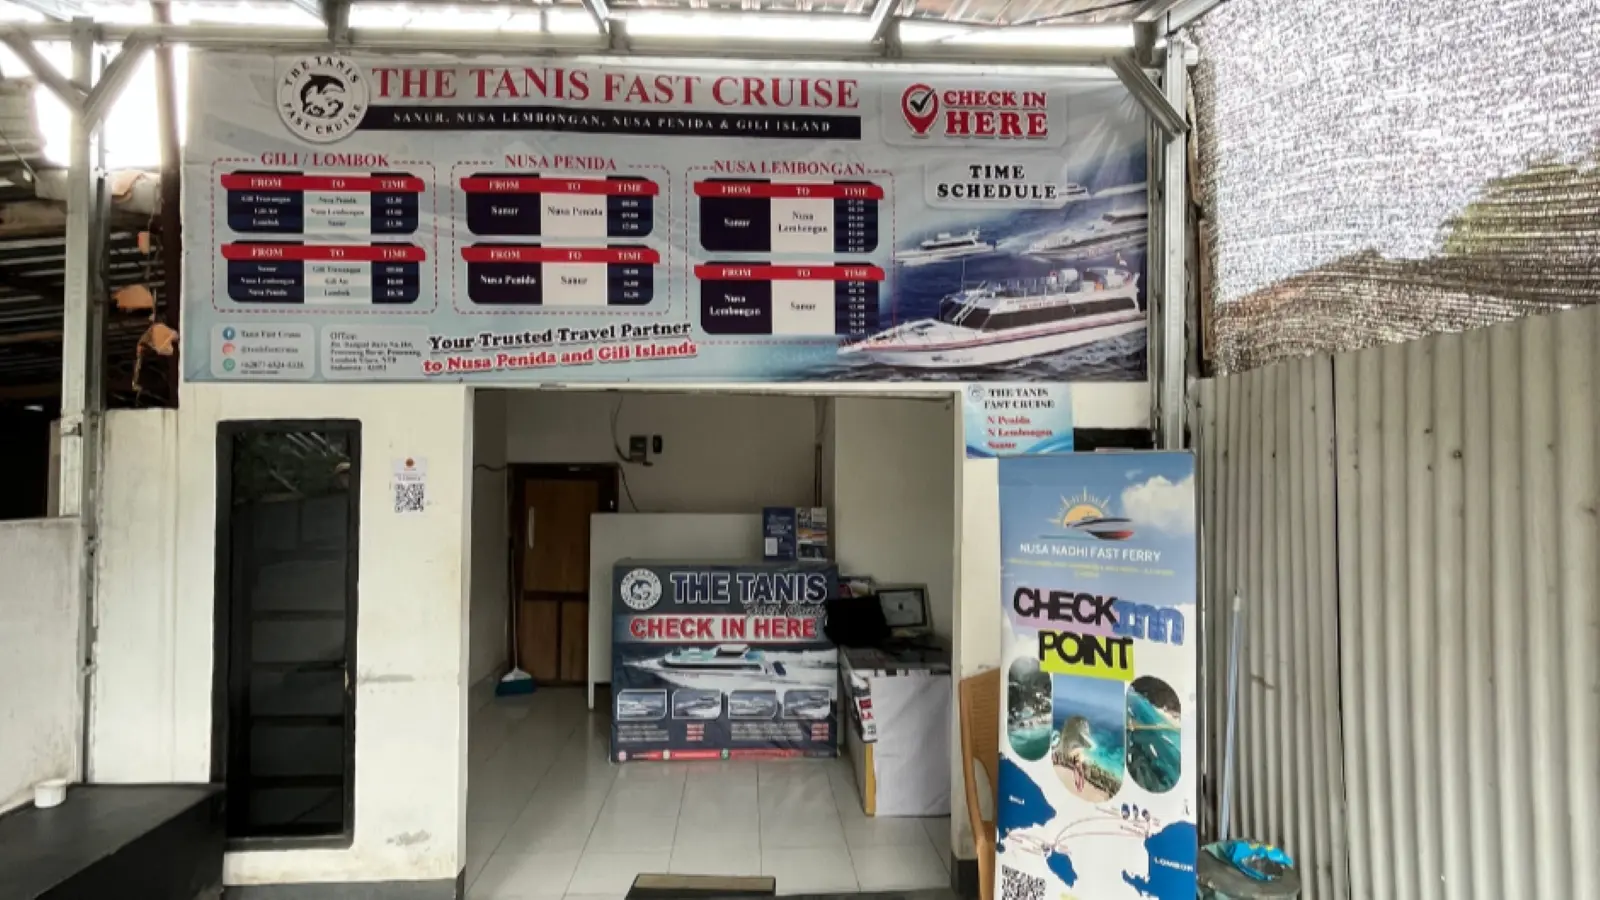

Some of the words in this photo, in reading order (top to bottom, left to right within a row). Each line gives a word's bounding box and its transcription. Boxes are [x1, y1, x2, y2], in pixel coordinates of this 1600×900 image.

[284, 60, 310, 86] THE
[315, 56, 359, 83] TANIS
[372, 67, 457, 98] THE
[470, 68, 589, 101] TANIS
[604, 72, 700, 105] FAST
[712, 76, 859, 109] CRUISE
[943, 90, 1017, 107] CHECK
[1023, 92, 1047, 107] IN
[284, 102, 311, 130] FAST
[315, 103, 361, 134] CRUISE
[393, 111, 450, 124] SANUR,
[457, 111, 495, 123] NUSA
[612, 116, 652, 128] NUSA
[657, 117, 714, 130] PENIDA
[719, 119, 730, 130] &
[736, 119, 769, 131] GILI
[776, 120, 831, 132] ISLAND
[945, 111, 1048, 137] HERE
[261, 152, 299, 167] GILI
[302, 154, 308, 167] /
[312, 153, 390, 168] LOMBOK
[504, 154, 549, 169] NUSA
[553, 156, 617, 171] PENIDA
[714, 160, 757, 174] NUSA
[761, 161, 866, 176] LEMBONGAN
[969, 164, 1025, 179] TIME
[251, 179, 283, 188] FROM
[332, 180, 345, 189] TO
[381, 180, 408, 189] TIME
[489, 181, 519, 190] FROM
[567, 182, 581, 191] TO
[617, 183, 642, 192] TIME
[721, 186, 751, 195] FROM
[796, 187, 810, 196] TO
[844, 187, 868, 197] TIME
[937, 183, 1057, 200] SCHEDULE
[491, 206, 519, 216] Sanur
[547, 206, 570, 217] Nusa
[572, 207, 603, 217] Penida
[792, 210, 814, 221] Nusa
[778, 223, 828, 235] Lembongan
[252, 248, 283, 258] FROM
[330, 249, 345, 258] TO
[382, 249, 408, 259] TIME
[490, 250, 521, 260] FROM
[568, 251, 582, 260] TO
[617, 251, 643, 261] TIME
[480, 274, 503, 285] Nusa
[504, 274, 536, 285] Penida
[560, 275, 588, 286] Sanur
[722, 267, 752, 277] FROM
[797, 268, 811, 277] TO
[844, 269, 868, 278] TIME
[429, 336, 475, 350] Your
[479, 329, 552, 347] Trusted
[557, 324, 615, 342] Travel
[621, 321, 691, 338] Partner
[423, 359, 442, 373] to
[447, 355, 491, 371] Nusa
[496, 351, 557, 367] Penida
[561, 348, 593, 363] and
[598, 345, 630, 361] Gili
[635, 341, 697, 358] Islands
[988, 388, 1013, 397] THE
[1016, 388, 1049, 397] TANIS
[984, 400, 1011, 409] FAST
[1012, 399, 1055, 409] CRUISE
[998, 415, 1031, 425] Penida
[1019, 543, 1049, 555] NUSA
[1052, 545, 1089, 557] NADHI
[1090, 546, 1119, 560] FAST
[1122, 548, 1162, 562] FERRY
[670, 572, 731, 604] THE
[736, 572, 828, 604] TANIS
[1013, 586, 1120, 626] CHECK
[630, 618, 713, 639] CHECK
[721, 619, 746, 639] IN
[754, 618, 817, 640] HERE
[1038, 630, 1134, 670] POINT
